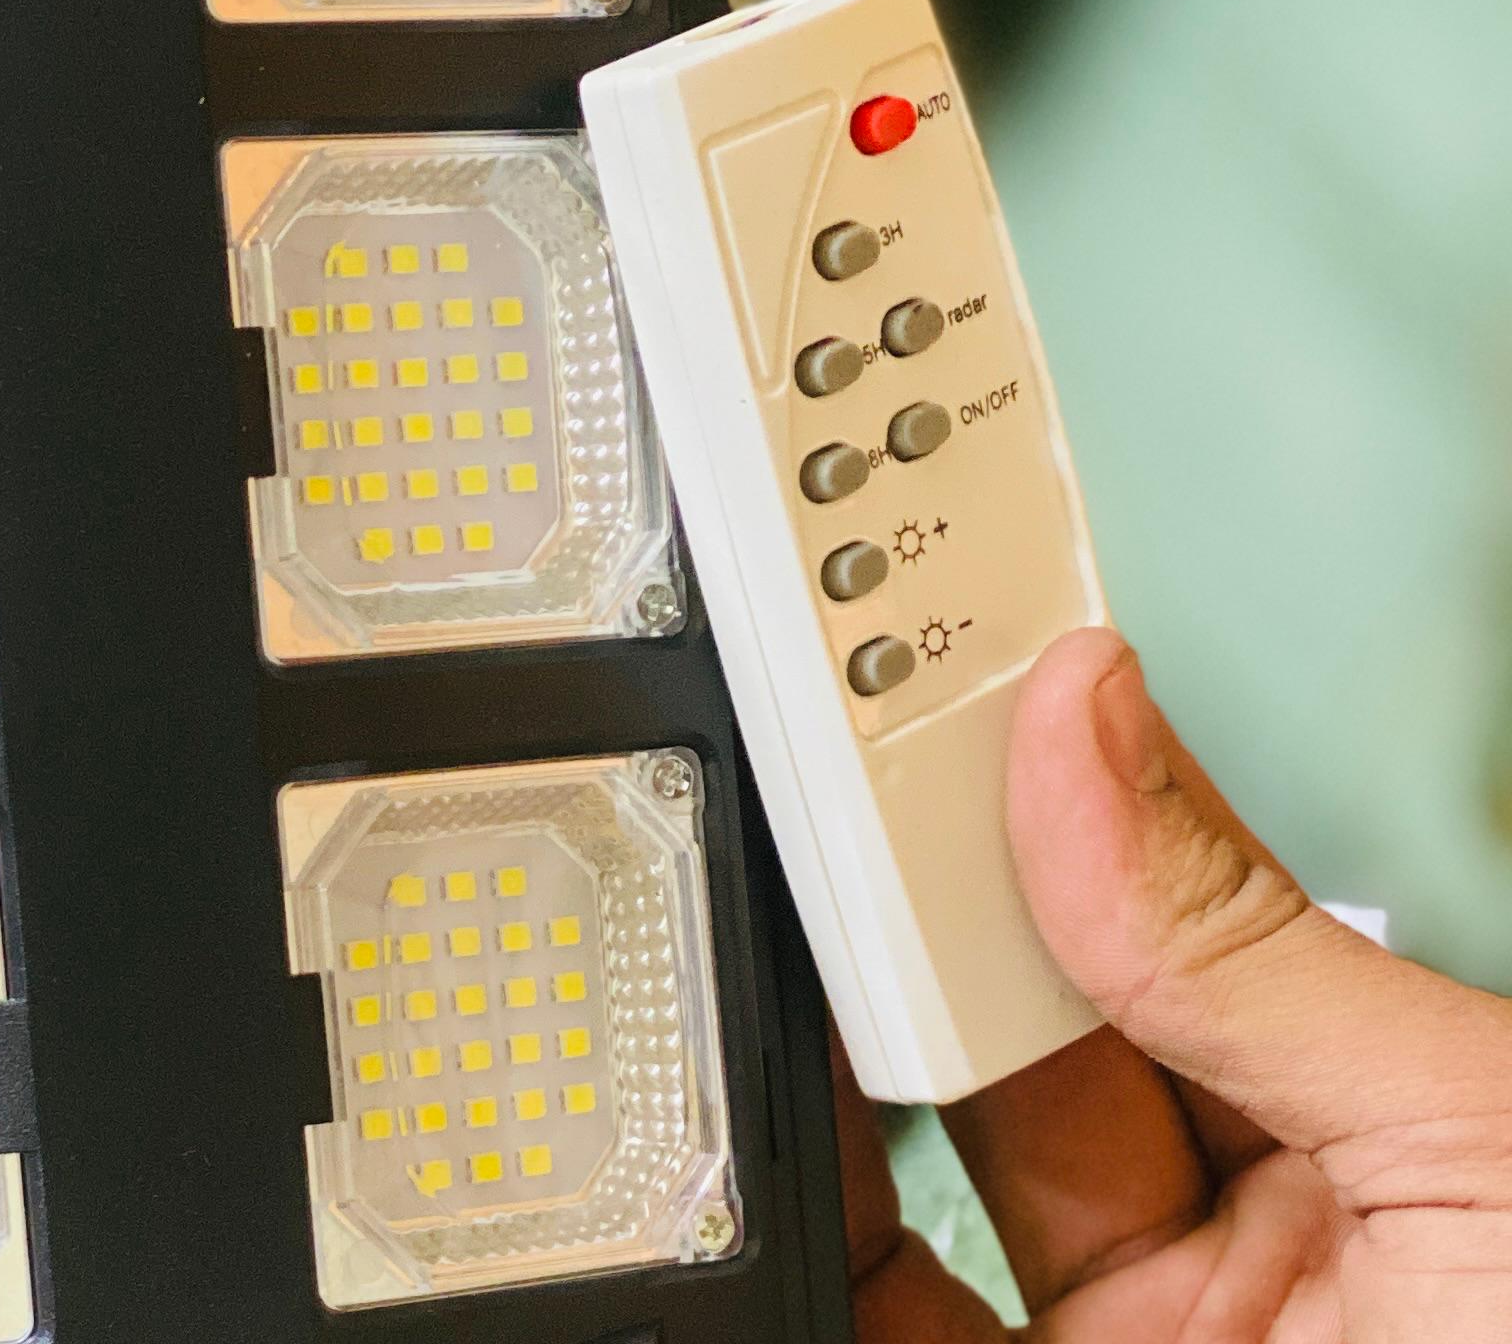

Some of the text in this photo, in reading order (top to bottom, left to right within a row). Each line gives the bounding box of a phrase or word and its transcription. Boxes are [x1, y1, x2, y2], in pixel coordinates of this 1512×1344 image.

[917, 91, 950, 122] AUTO
[879, 219, 904, 246] 3H
[947, 292, 988, 327] radar
[960, 381, 1019, 425] ON/OFF
